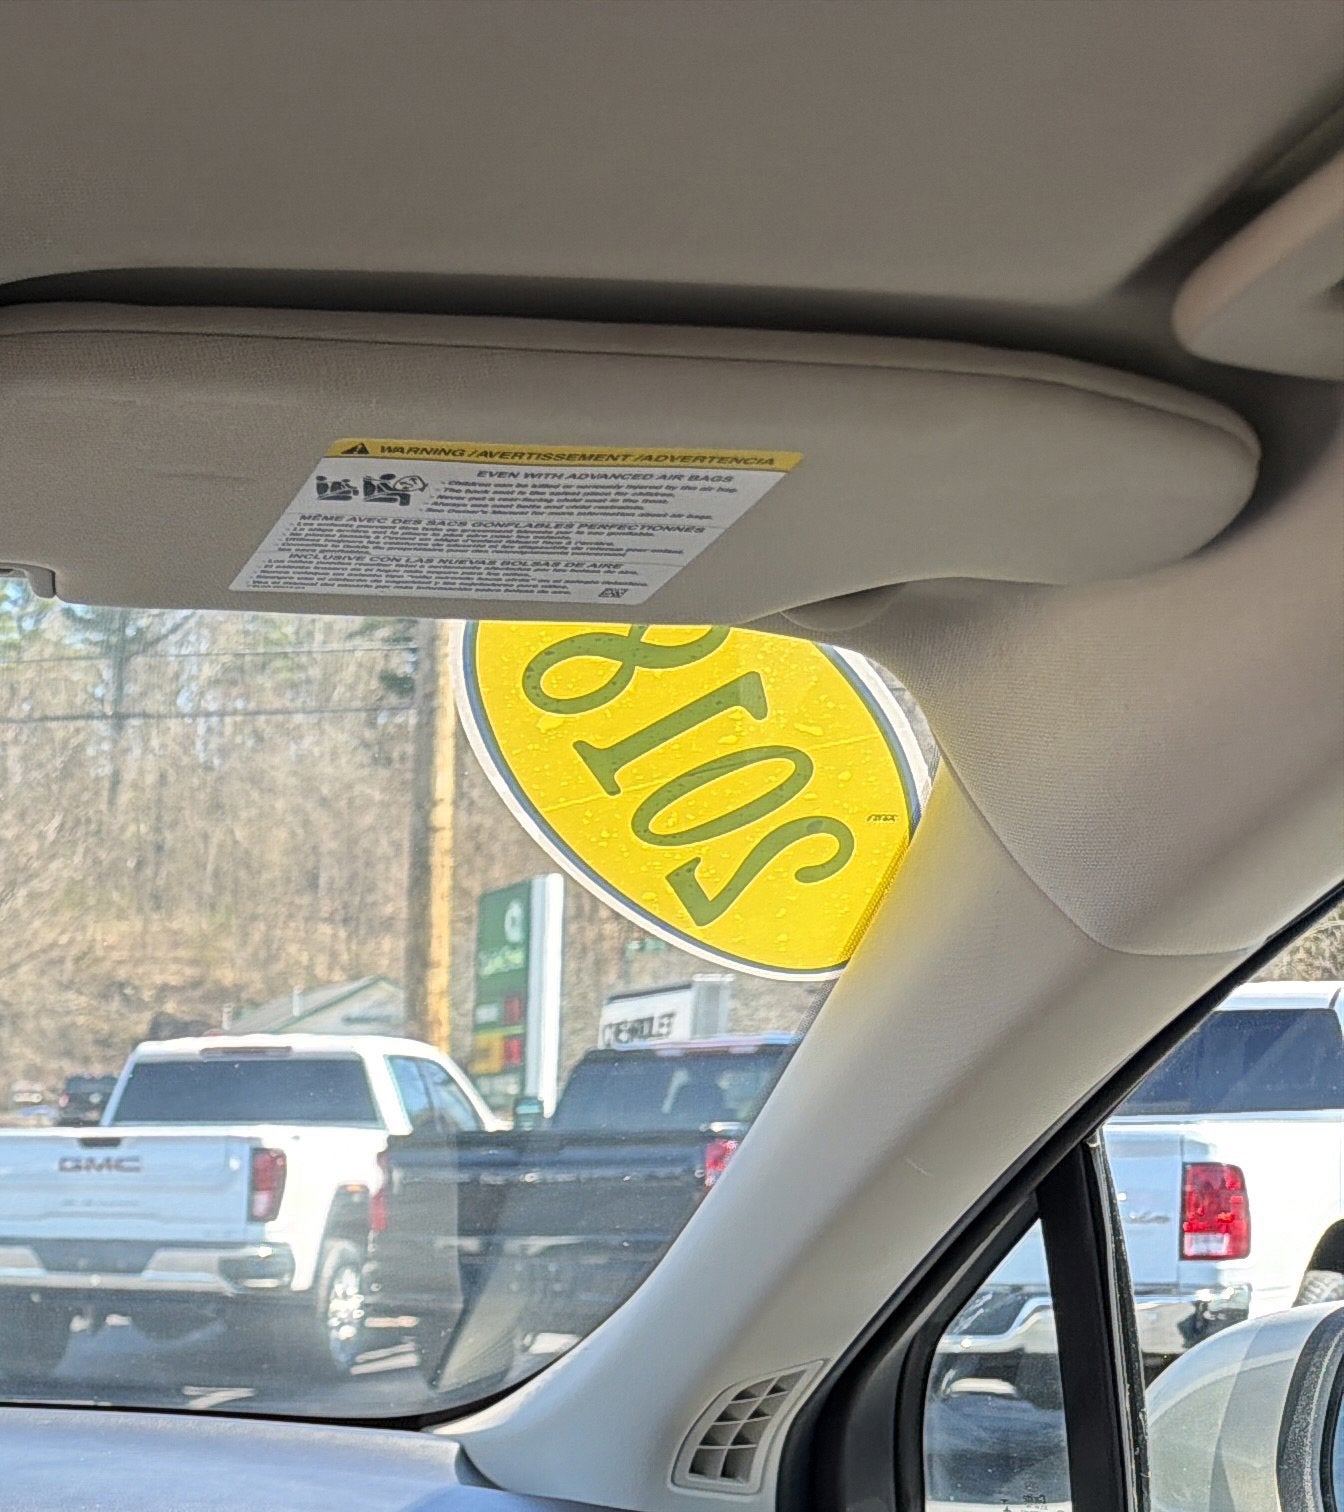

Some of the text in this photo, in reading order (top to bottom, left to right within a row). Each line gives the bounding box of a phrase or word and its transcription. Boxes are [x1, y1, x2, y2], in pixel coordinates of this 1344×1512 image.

[380, 446, 464, 457] WARNING
[477, 470, 734, 483] EVEN WITH ADVANCED AIR BAGS
[346, 516, 389, 524] AVEC
[391, 518, 424, 526] DES
[370, 555, 404, 563] CON
[405, 556, 435, 564] LAS
[58, 1156, 142, 1173] GMC
